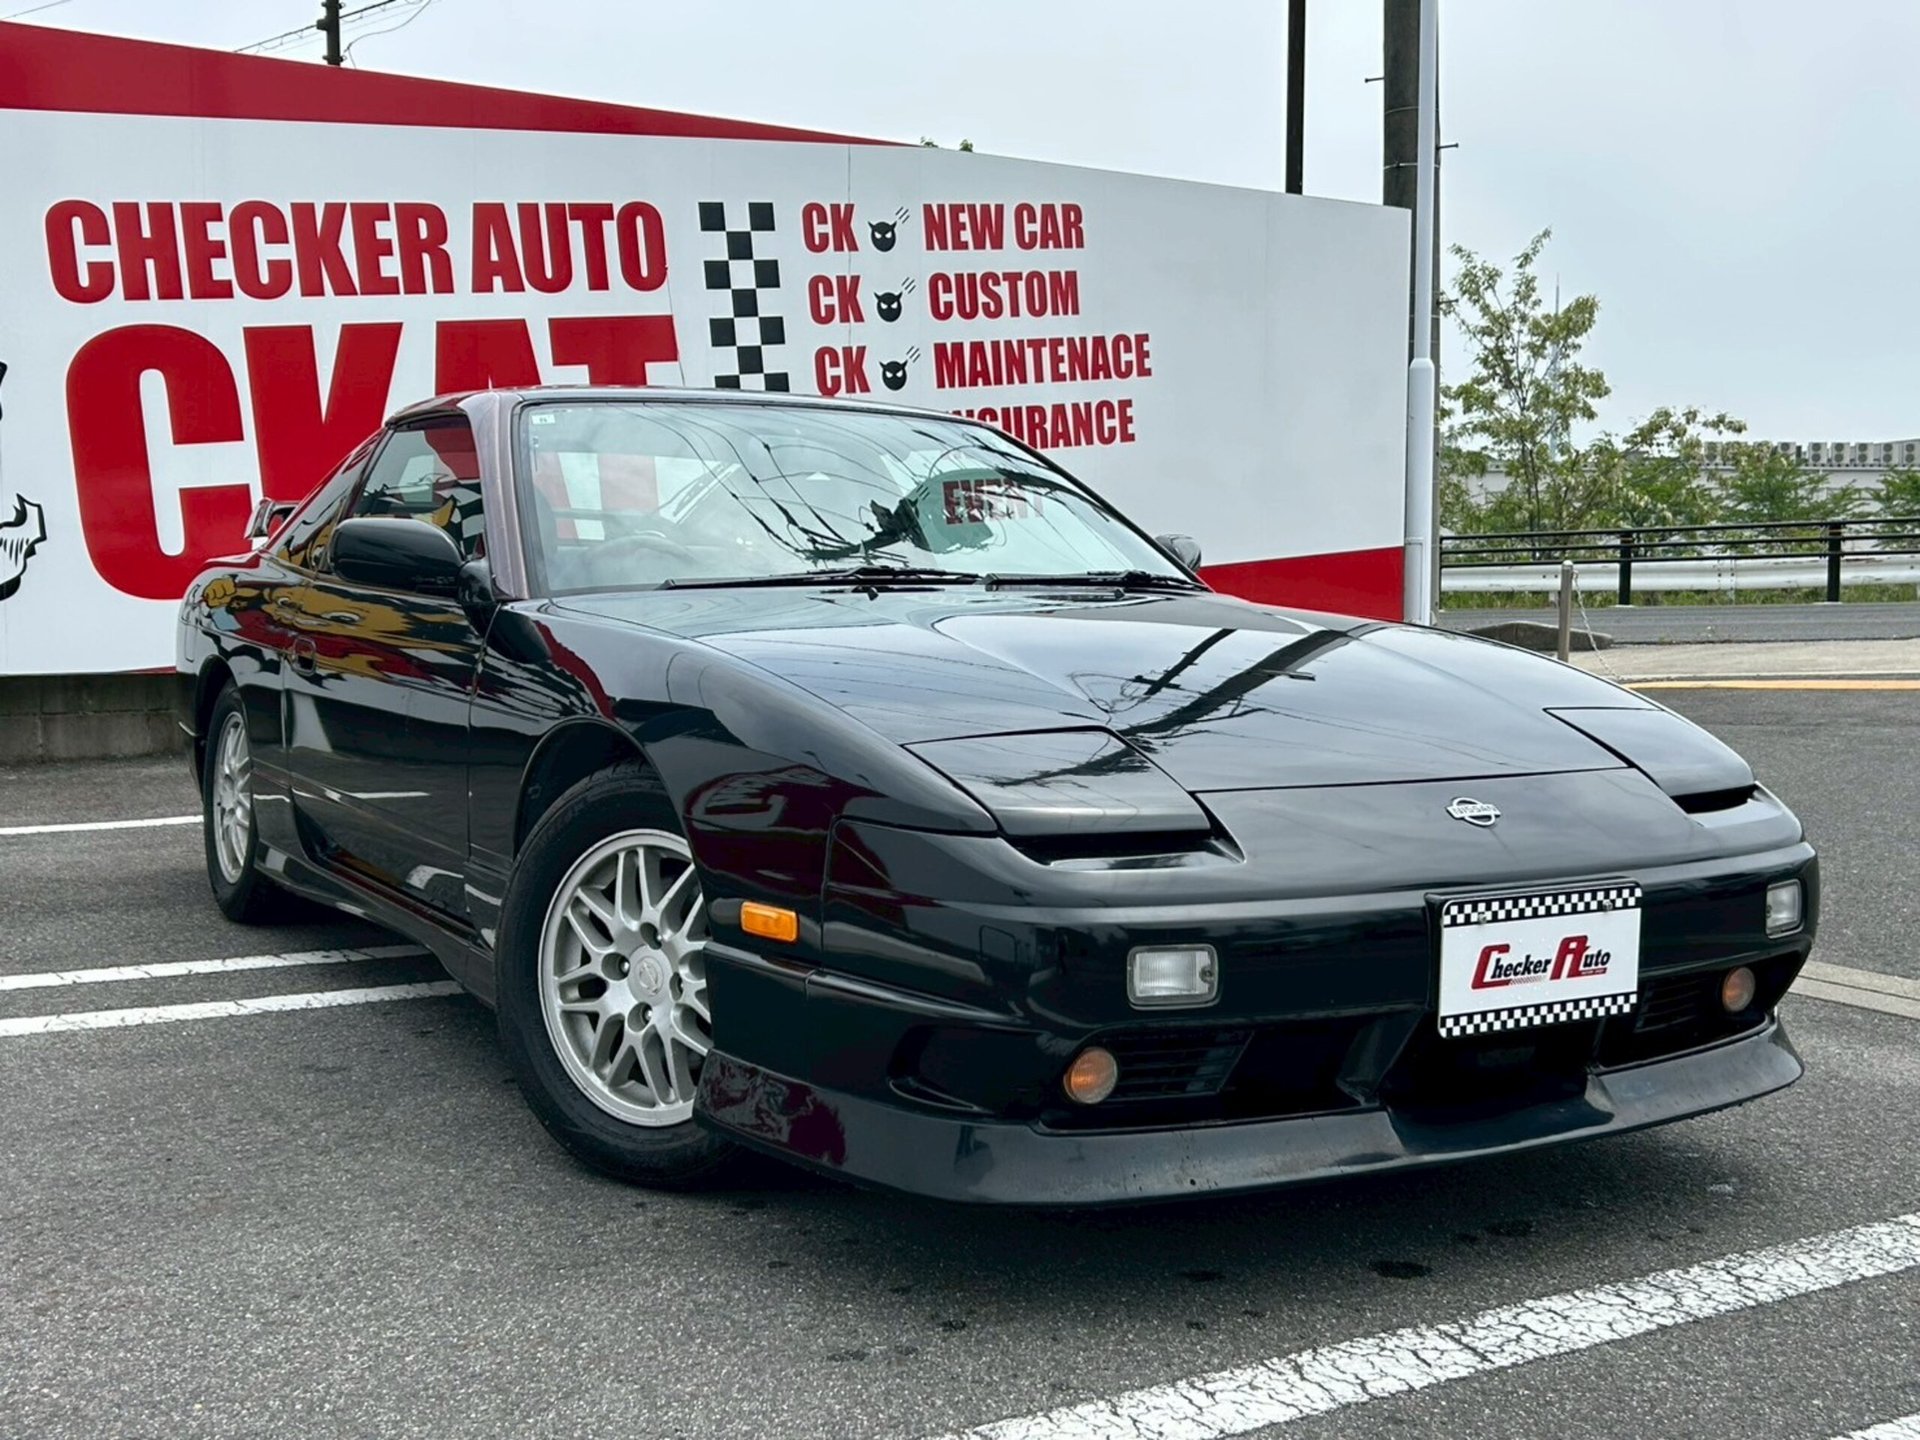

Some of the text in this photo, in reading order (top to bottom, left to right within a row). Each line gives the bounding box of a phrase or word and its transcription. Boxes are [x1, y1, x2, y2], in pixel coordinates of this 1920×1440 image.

[45, 200, 668, 304] CHECKER AUTO
[802, 203, 1084, 252] CK NEW CAR
[808, 271, 1079, 324] CK CUSTOM
[814, 334, 1151, 395] CK MAINTENACE
[948, 399, 1135, 449] URANCE
[66, 315, 679, 600] CK
[1471, 935, 1611, 989] Checker Auto
